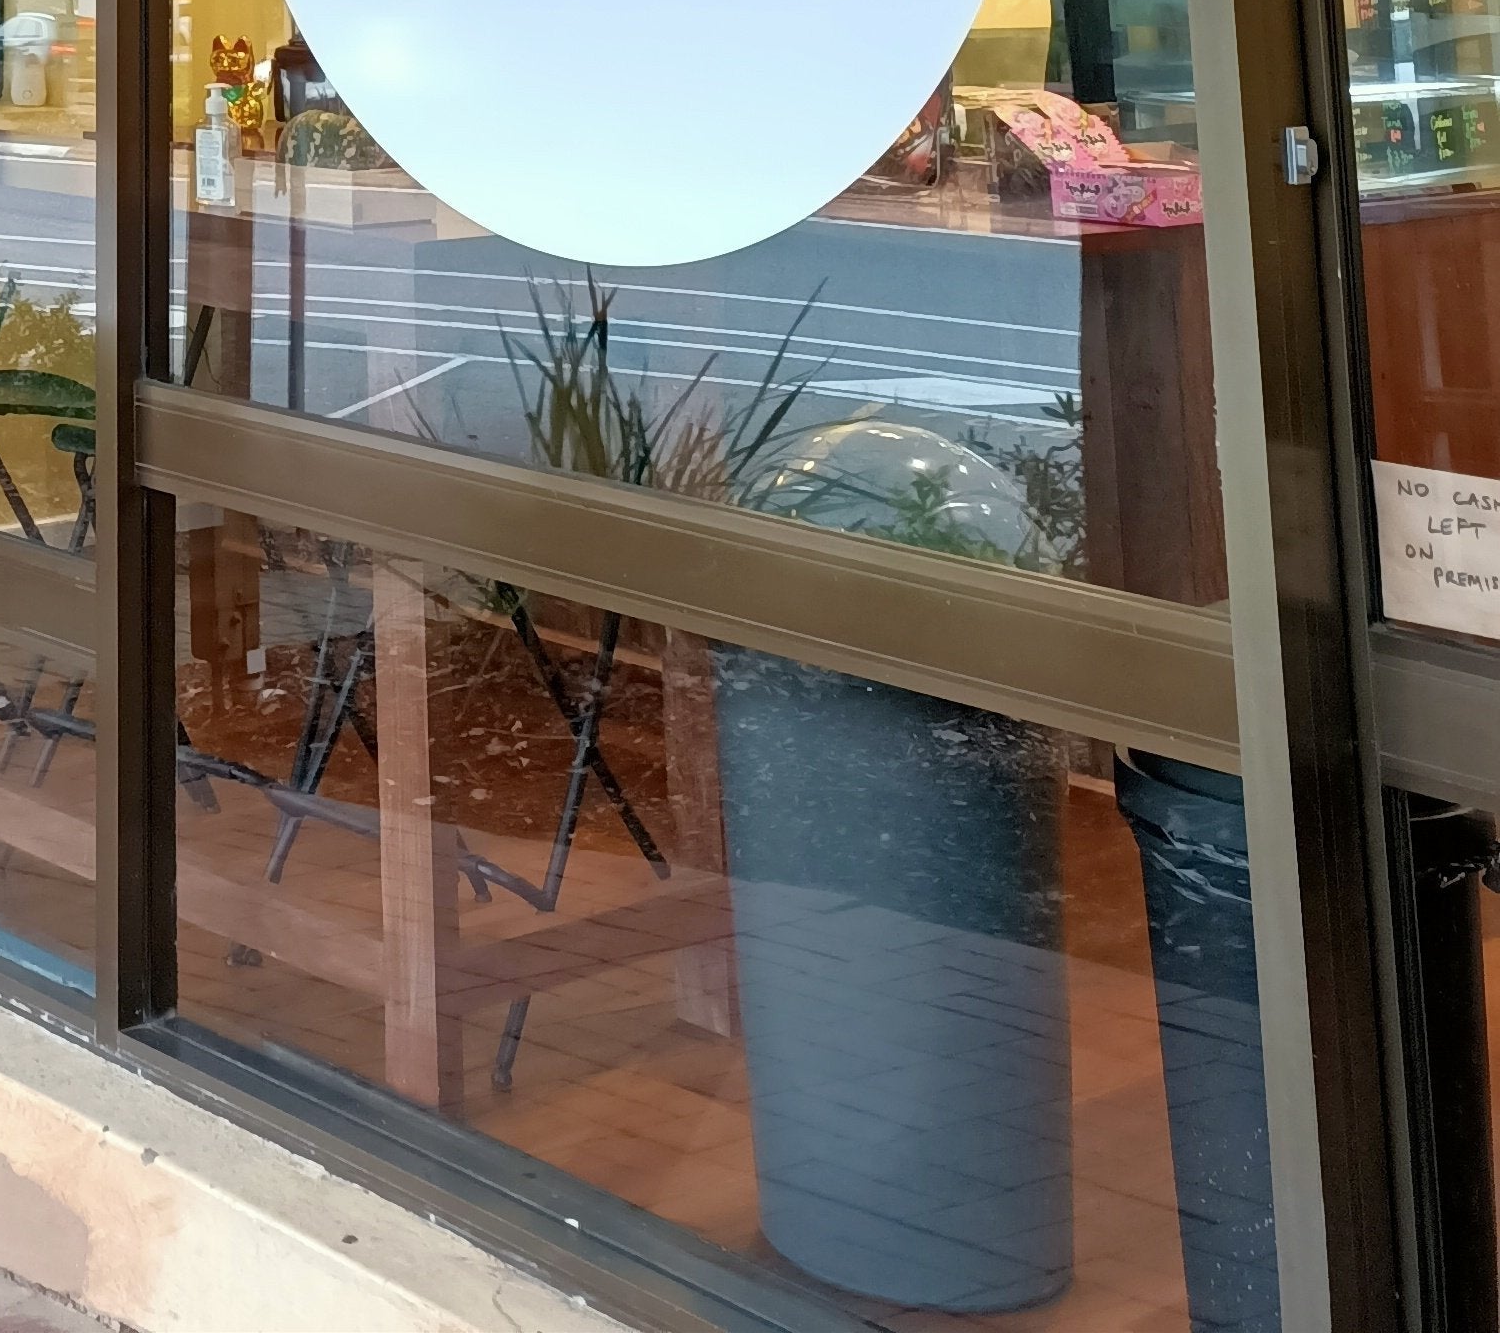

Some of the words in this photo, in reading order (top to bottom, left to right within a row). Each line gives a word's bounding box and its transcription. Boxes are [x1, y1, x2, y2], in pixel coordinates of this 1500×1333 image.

[1397, 479, 1430, 498] NO
[1427, 515, 1487, 539] LEFT
[1405, 543, 1434, 560] ON
